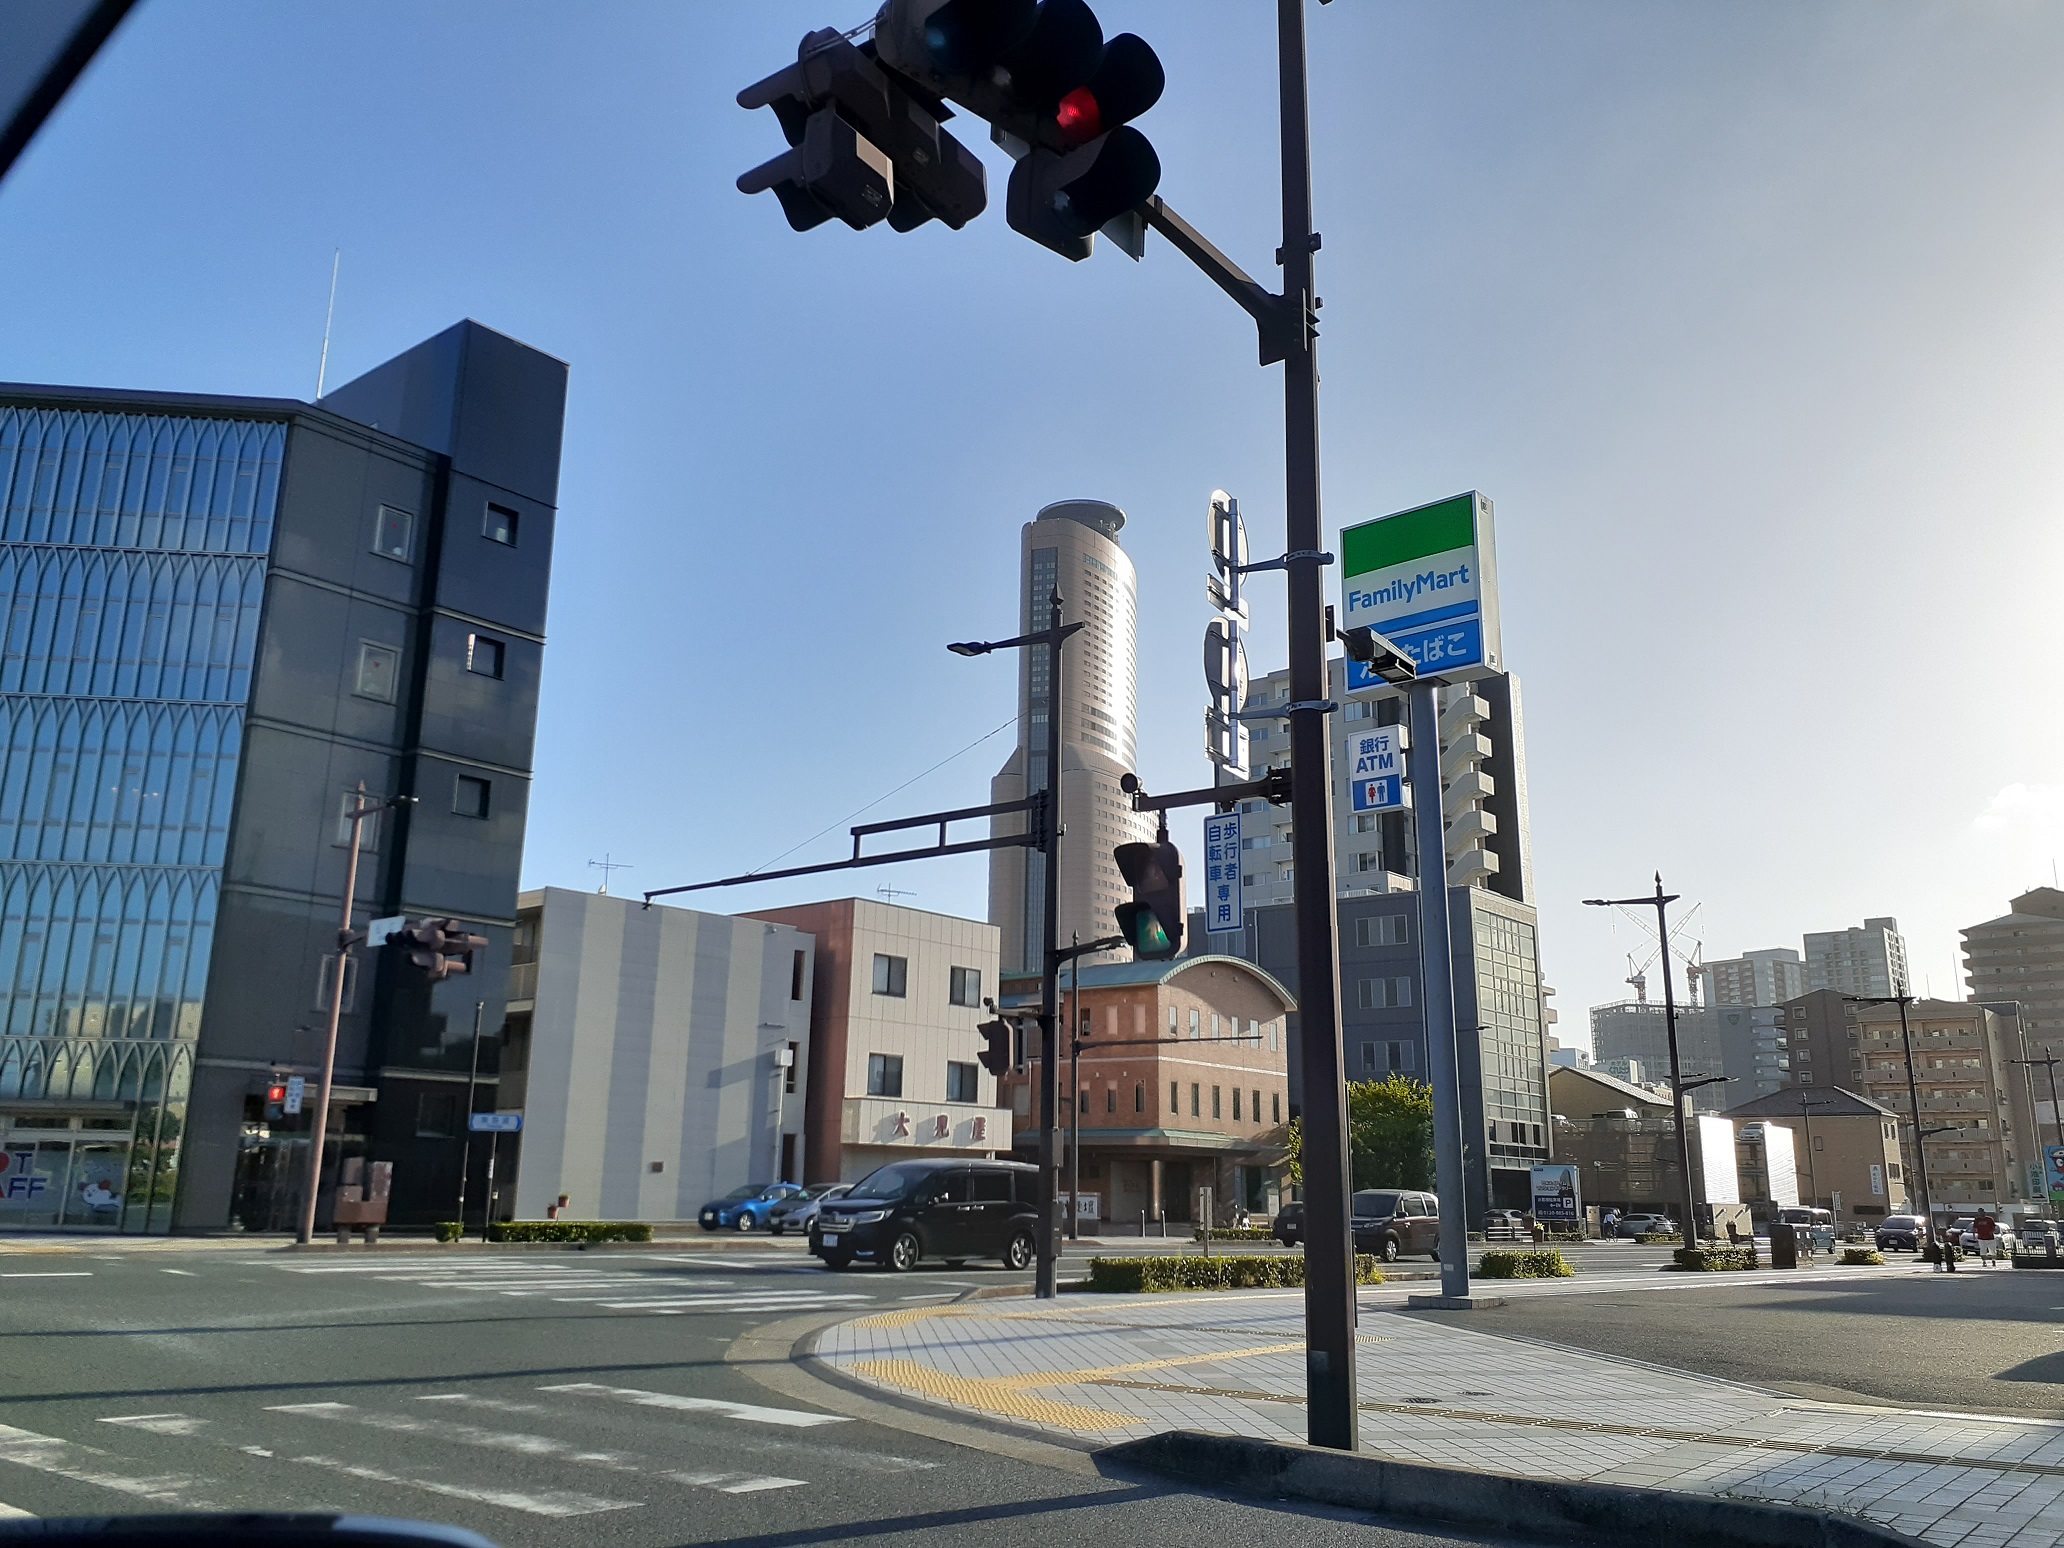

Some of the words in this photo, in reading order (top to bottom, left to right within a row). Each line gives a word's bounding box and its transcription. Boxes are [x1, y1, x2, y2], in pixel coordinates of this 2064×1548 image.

[1349, 564, 1469, 612] FamilyMart
[1356, 752, 1394, 774] ATM
[1360, 735, 1389, 755] 銀行
[1208, 825, 1222, 882] 自転車
[1223, 822, 1238, 880] 歩行者
[1217, 884, 1231, 923] 専用
[1566, 1199, 1571, 1207] P
